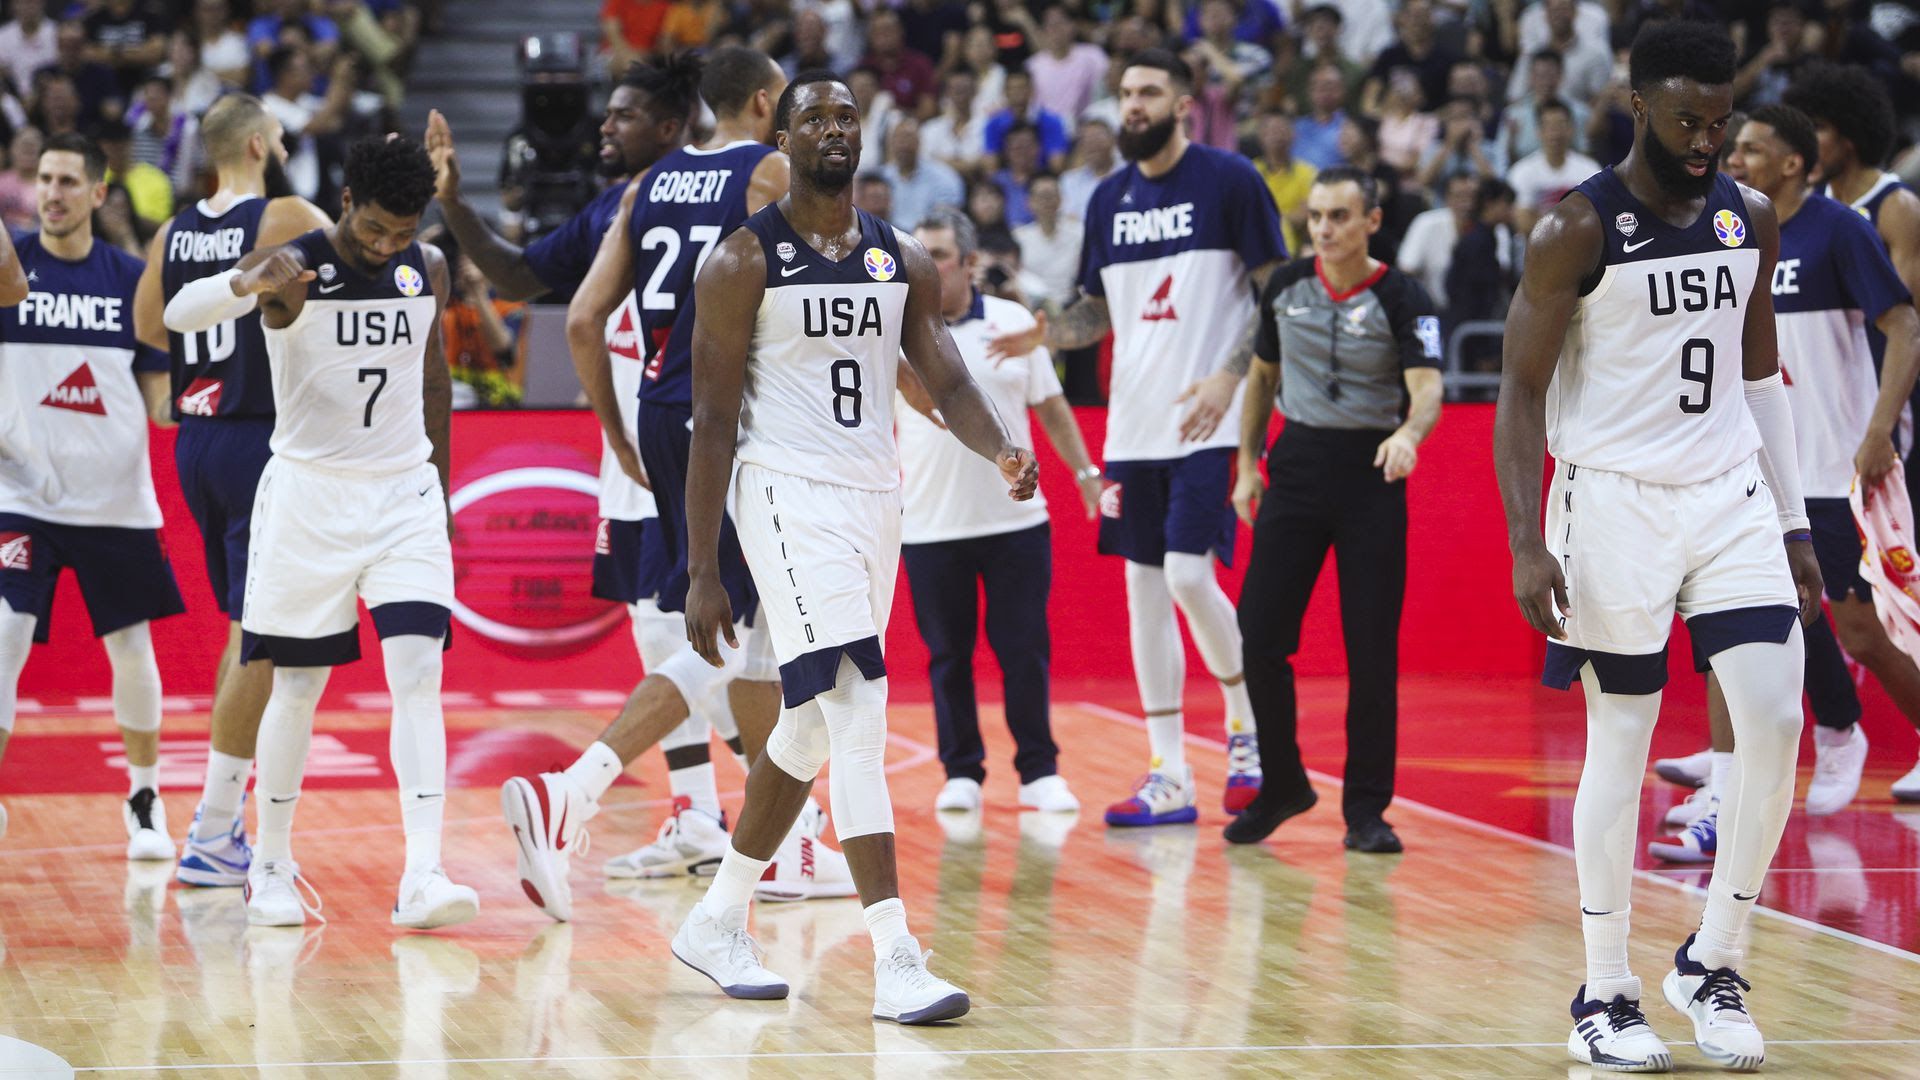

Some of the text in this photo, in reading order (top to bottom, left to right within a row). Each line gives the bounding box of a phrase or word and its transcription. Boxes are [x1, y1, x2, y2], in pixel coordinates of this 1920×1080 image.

[650, 170, 732, 203] GOBERT
[169, 227, 245, 262] FOURNER
[1112, 202, 1194, 246] FRANCE
[641, 226, 722, 310] 27
[1648, 265, 1737, 316] USA
[18, 291, 123, 332] FRANCE
[337, 311, 412, 346] USA
[803, 297, 882, 338] USA
[358, 368, 387, 427] 7
[831, 359, 863, 428] 8
[1679, 338, 1715, 414] 9
[765, 485, 815, 644] UNITED
[1558, 463, 1576, 630] UNIT
